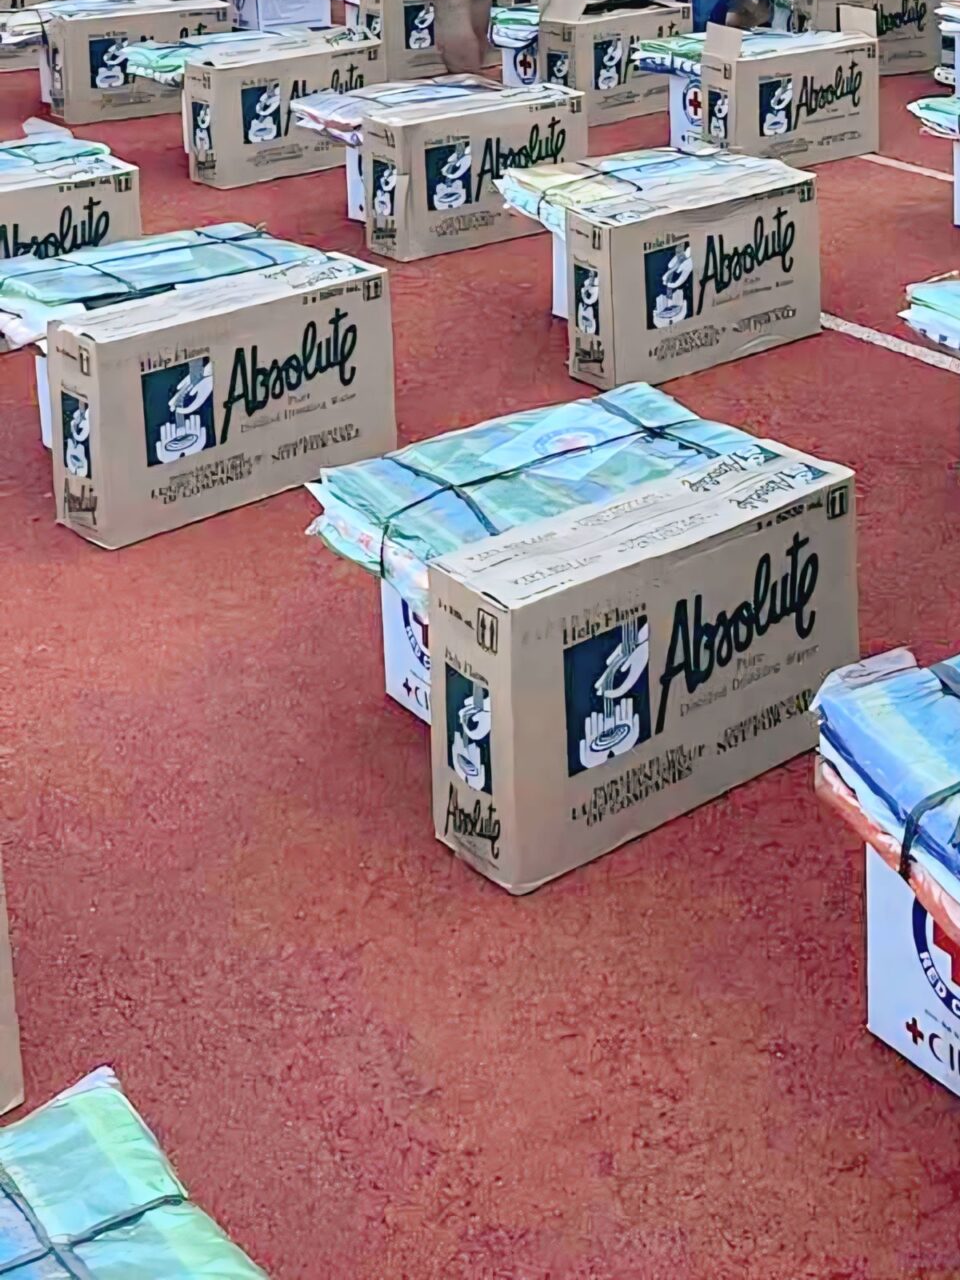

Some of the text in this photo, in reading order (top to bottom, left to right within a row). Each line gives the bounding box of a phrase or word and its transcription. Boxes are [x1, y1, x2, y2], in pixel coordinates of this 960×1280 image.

[794, 58, 862, 130] Absolute
[697, 207, 795, 315] Absolute
[219, 308, 357, 444] Absolute
[655, 532, 819, 735] Absolute
